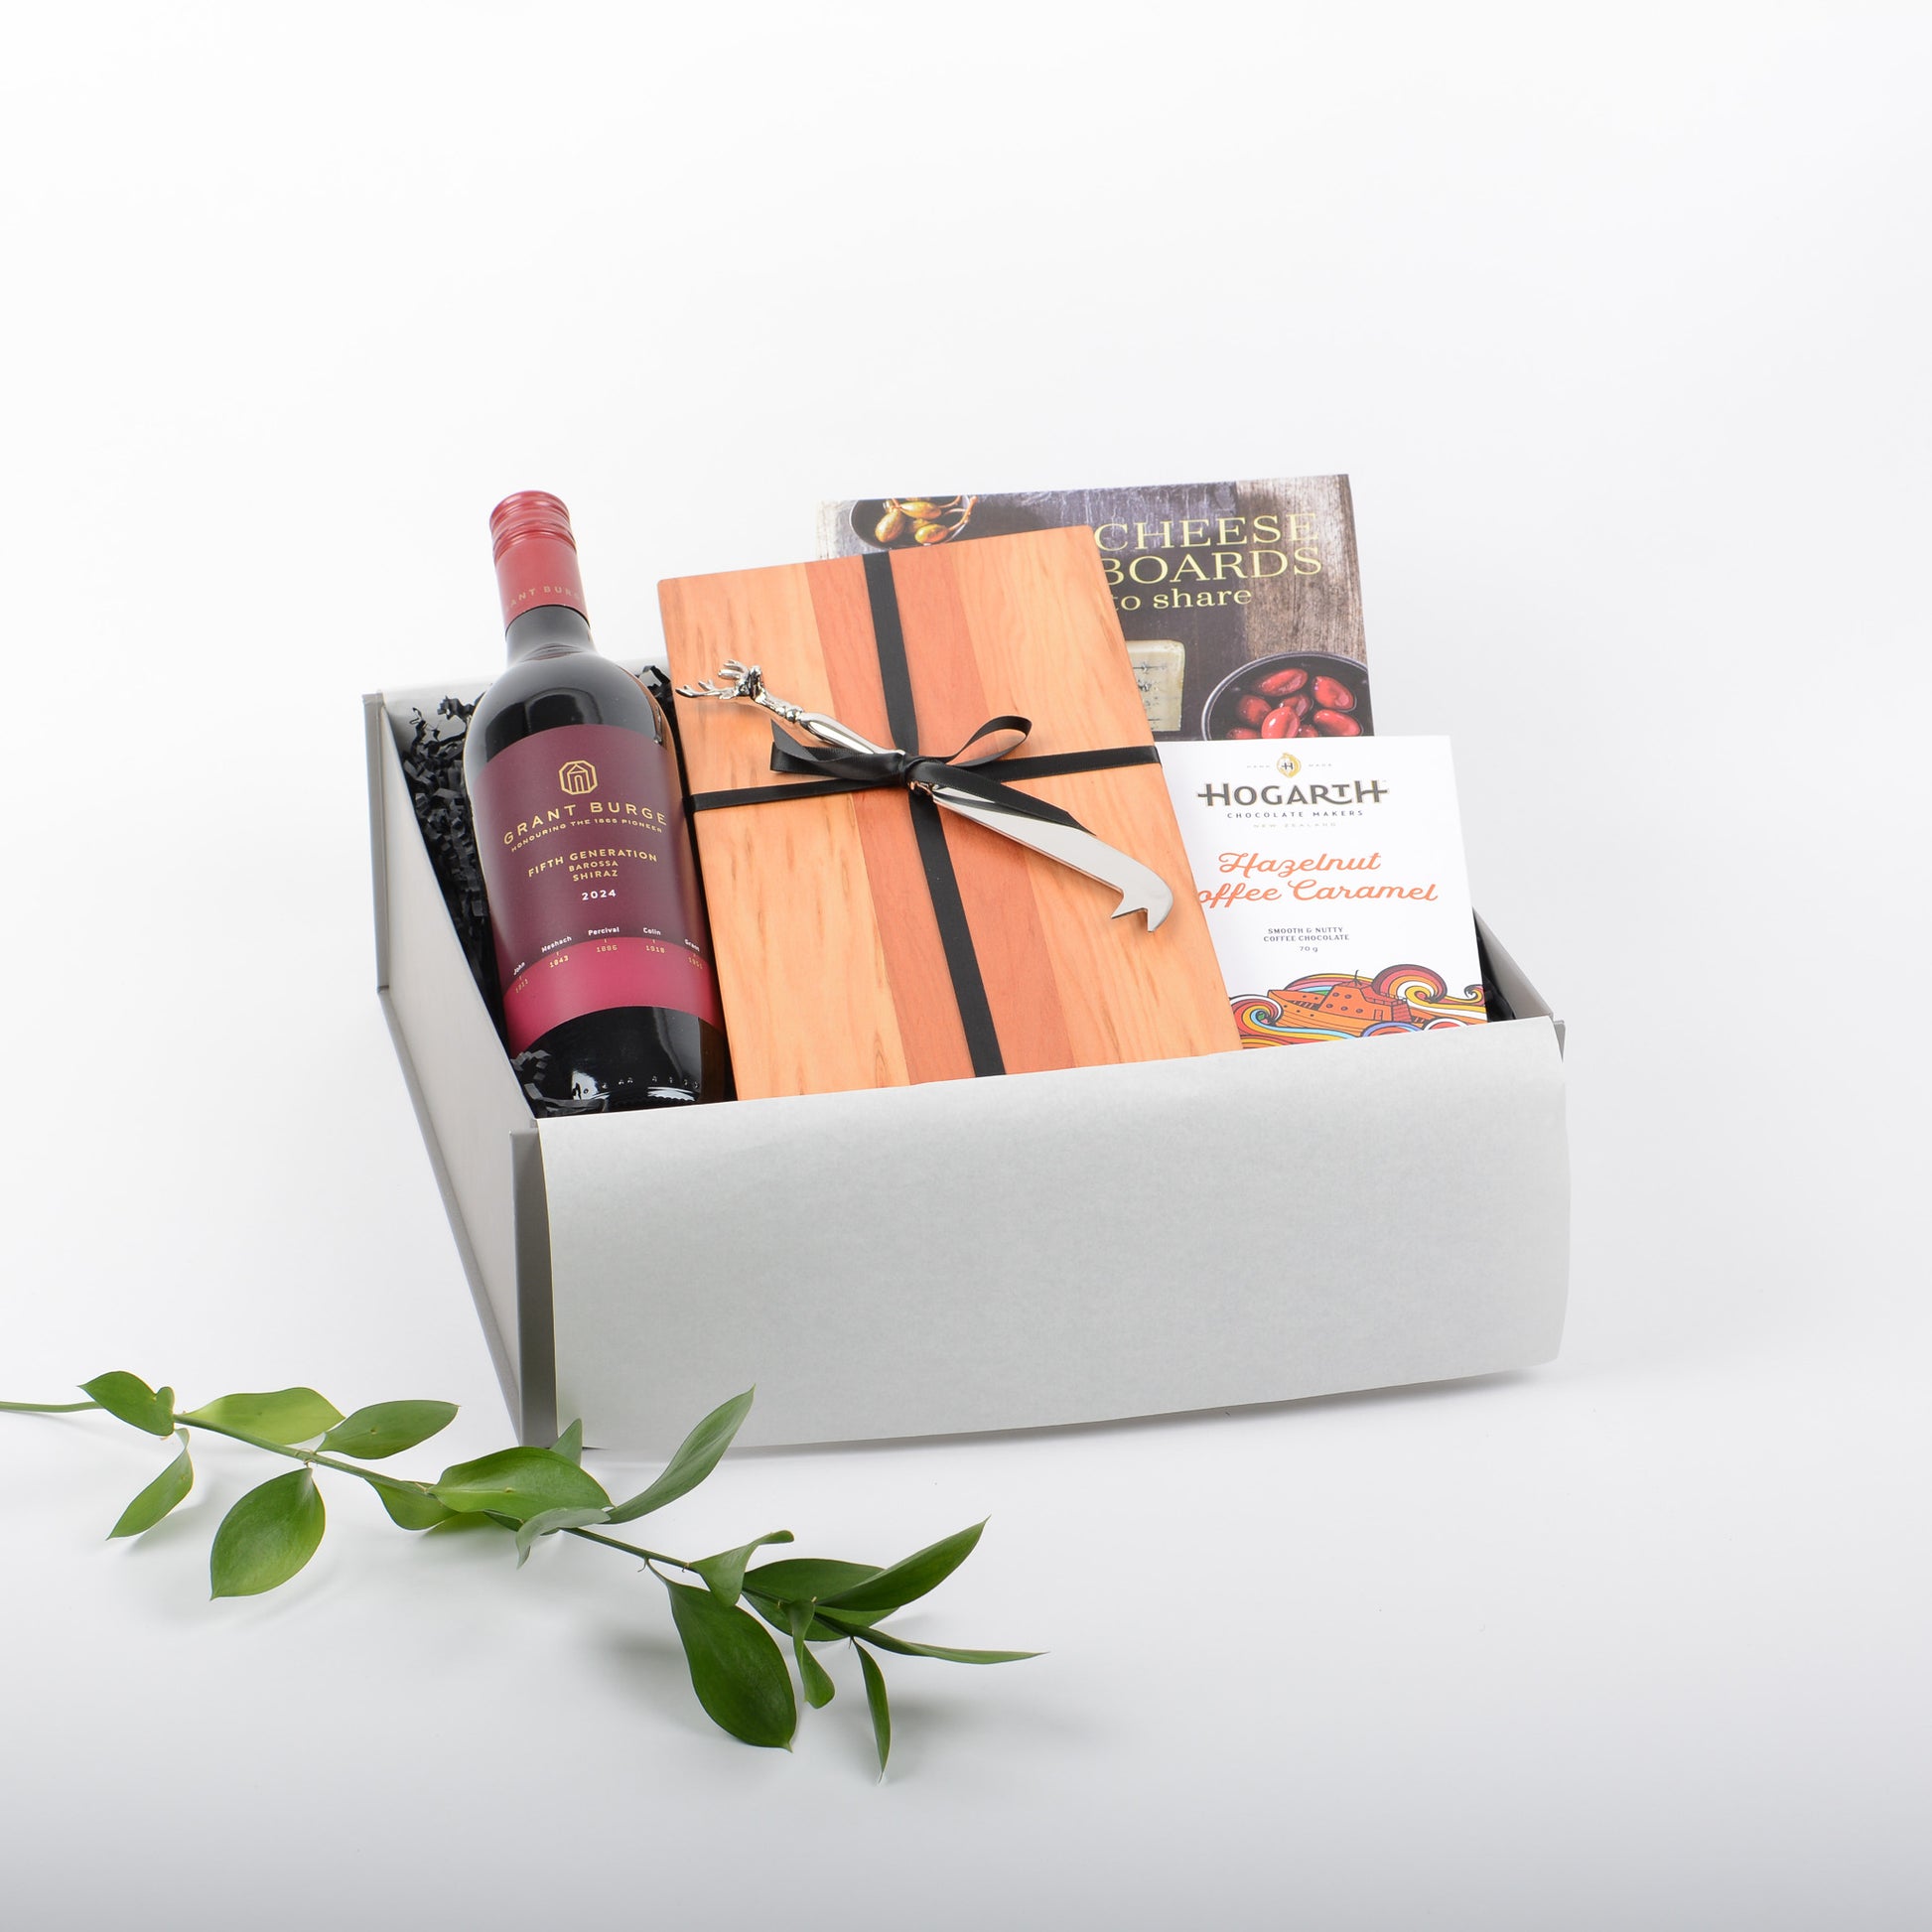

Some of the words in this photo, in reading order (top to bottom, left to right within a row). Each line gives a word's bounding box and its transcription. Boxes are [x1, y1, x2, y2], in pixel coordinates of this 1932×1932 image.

[1094, 513, 1319, 552] CHEESE
[1101, 546, 1322, 586] BOARDS
[1153, 588, 1252, 611] share
[1197, 779, 1388, 807] HOGARTH
[503, 803, 577, 845] GRANT
[590, 801, 667, 826] BURGE
[510, 823, 567, 853] HONOURING
[621, 819, 662, 833] PIONEER
[528, 856, 564, 878] FIFTH
[569, 848, 658, 863] GENERATION
[569, 860, 619, 873] BAROSSA
[573, 870, 619, 882] SHIRAZ
[1218, 852, 1381, 879] Hazelnut
[582, 889, 617, 900] 2024
[1197, 882, 1282, 908] offee
[1288, 879, 1439, 901] Caramel
[541, 936, 572, 953] Meshach
[588, 926, 621, 936] Percival
[643, 926, 661, 936] Colin
